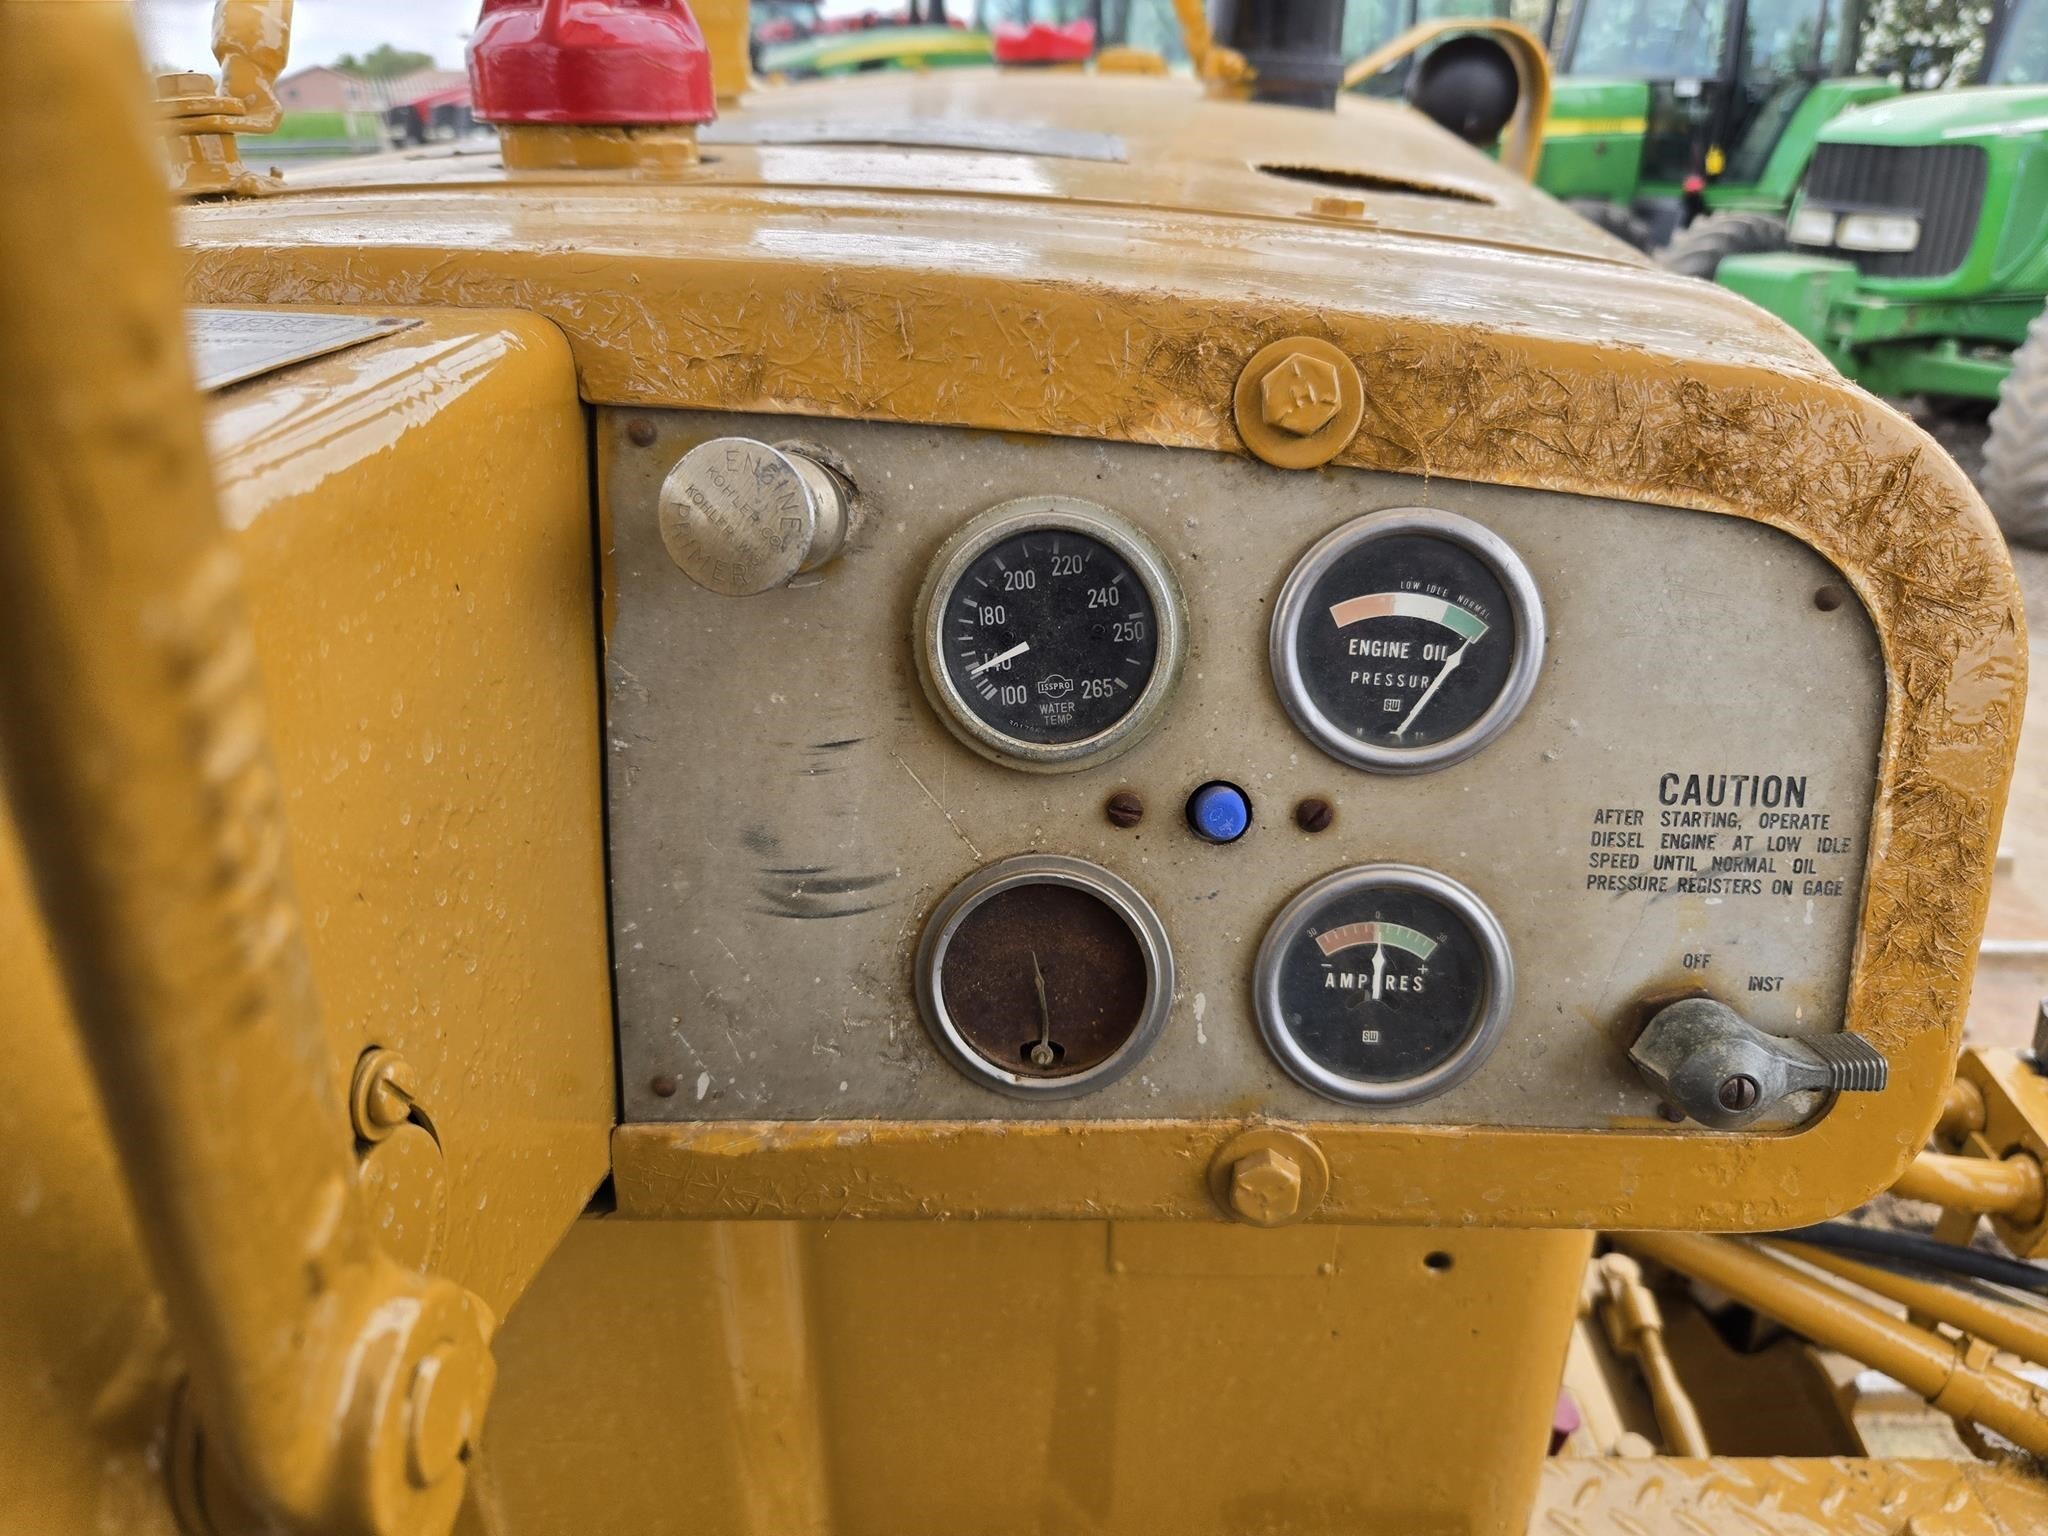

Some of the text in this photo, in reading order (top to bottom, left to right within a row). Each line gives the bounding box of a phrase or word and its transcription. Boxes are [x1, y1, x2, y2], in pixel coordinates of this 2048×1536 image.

[706, 465, 761, 526] KOHLER
[725, 450, 802, 533] ENGINE
[671, 501, 750, 586] PRIMER
[1051, 554, 1083, 577] 220
[1004, 569, 1036, 592] 200
[1400, 581, 1449, 597] LOW IDLE
[1087, 586, 1120, 609] 240
[1457, 595, 1490, 620] NORMAL
[979, 605, 1006, 626] 180
[1112, 621, 1145, 643] 250
[1348, 638, 1448, 661] ENGINE OIL
[1041, 682, 1071, 691] ISSPRO
[1081, 678, 1114, 700] 265
[1350, 671, 1440, 690] PRESSUR
[1001, 685, 1028, 706] 100
[1039, 702, 1075, 715] WATER
[1044, 713, 1073, 727] TEMP
[1658, 772, 1807, 808] CAUTION
[1593, 809, 1831, 830] AFTER STARTING, OPERATE
[1590, 831, 1852, 854] DIESEL ENGINE AT LOW IDLE
[1588, 853, 1817, 875] SPEED UNTIL NORMAL OIL
[1586, 875, 1844, 897] PRESSURE REGISTERS ON GAGE
[1307, 927, 1318, 938] 30
[1682, 953, 1712, 969] OFF
[1325, 973, 1424, 992] AMPRES
[1748, 976, 1784, 992] INST
[1362, 1030, 1379, 1042] SW
